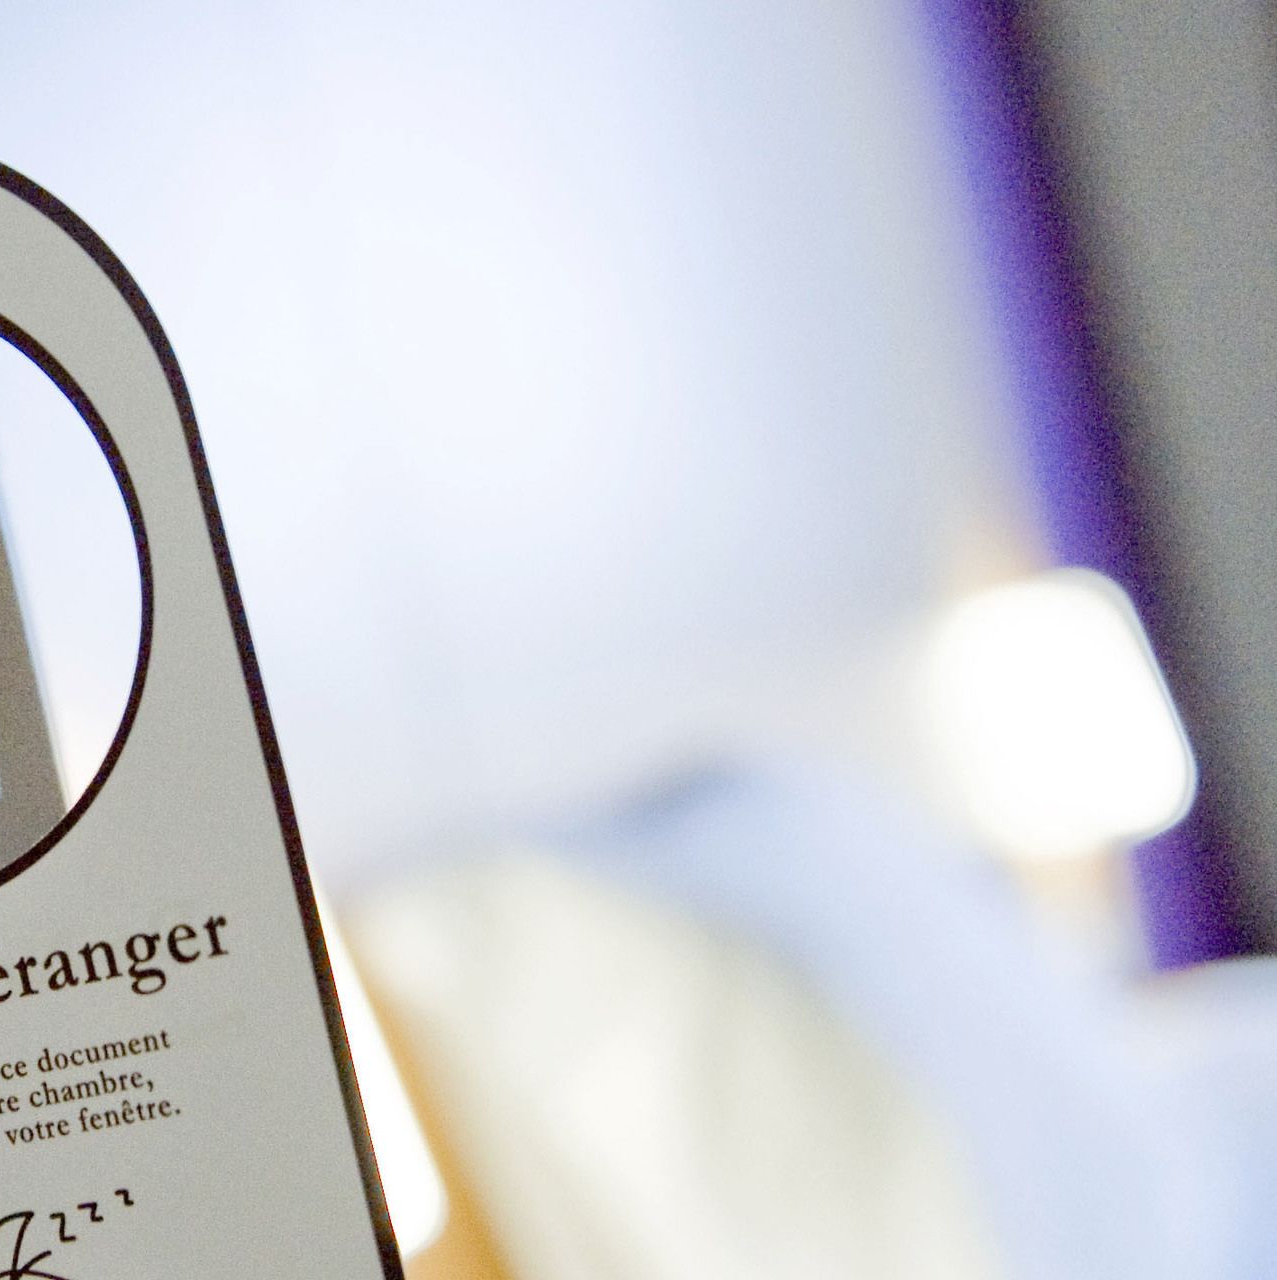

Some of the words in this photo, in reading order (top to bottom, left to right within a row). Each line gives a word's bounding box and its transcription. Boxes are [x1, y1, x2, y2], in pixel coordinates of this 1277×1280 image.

[0, 1060, 28, 1080] ce
[37, 1029, 171, 1073] document
[29, 1070, 155, 1108] chambre,
[5, 1119, 70, 1146] votre
[78, 1099, 181, 1132] fenêtre.
